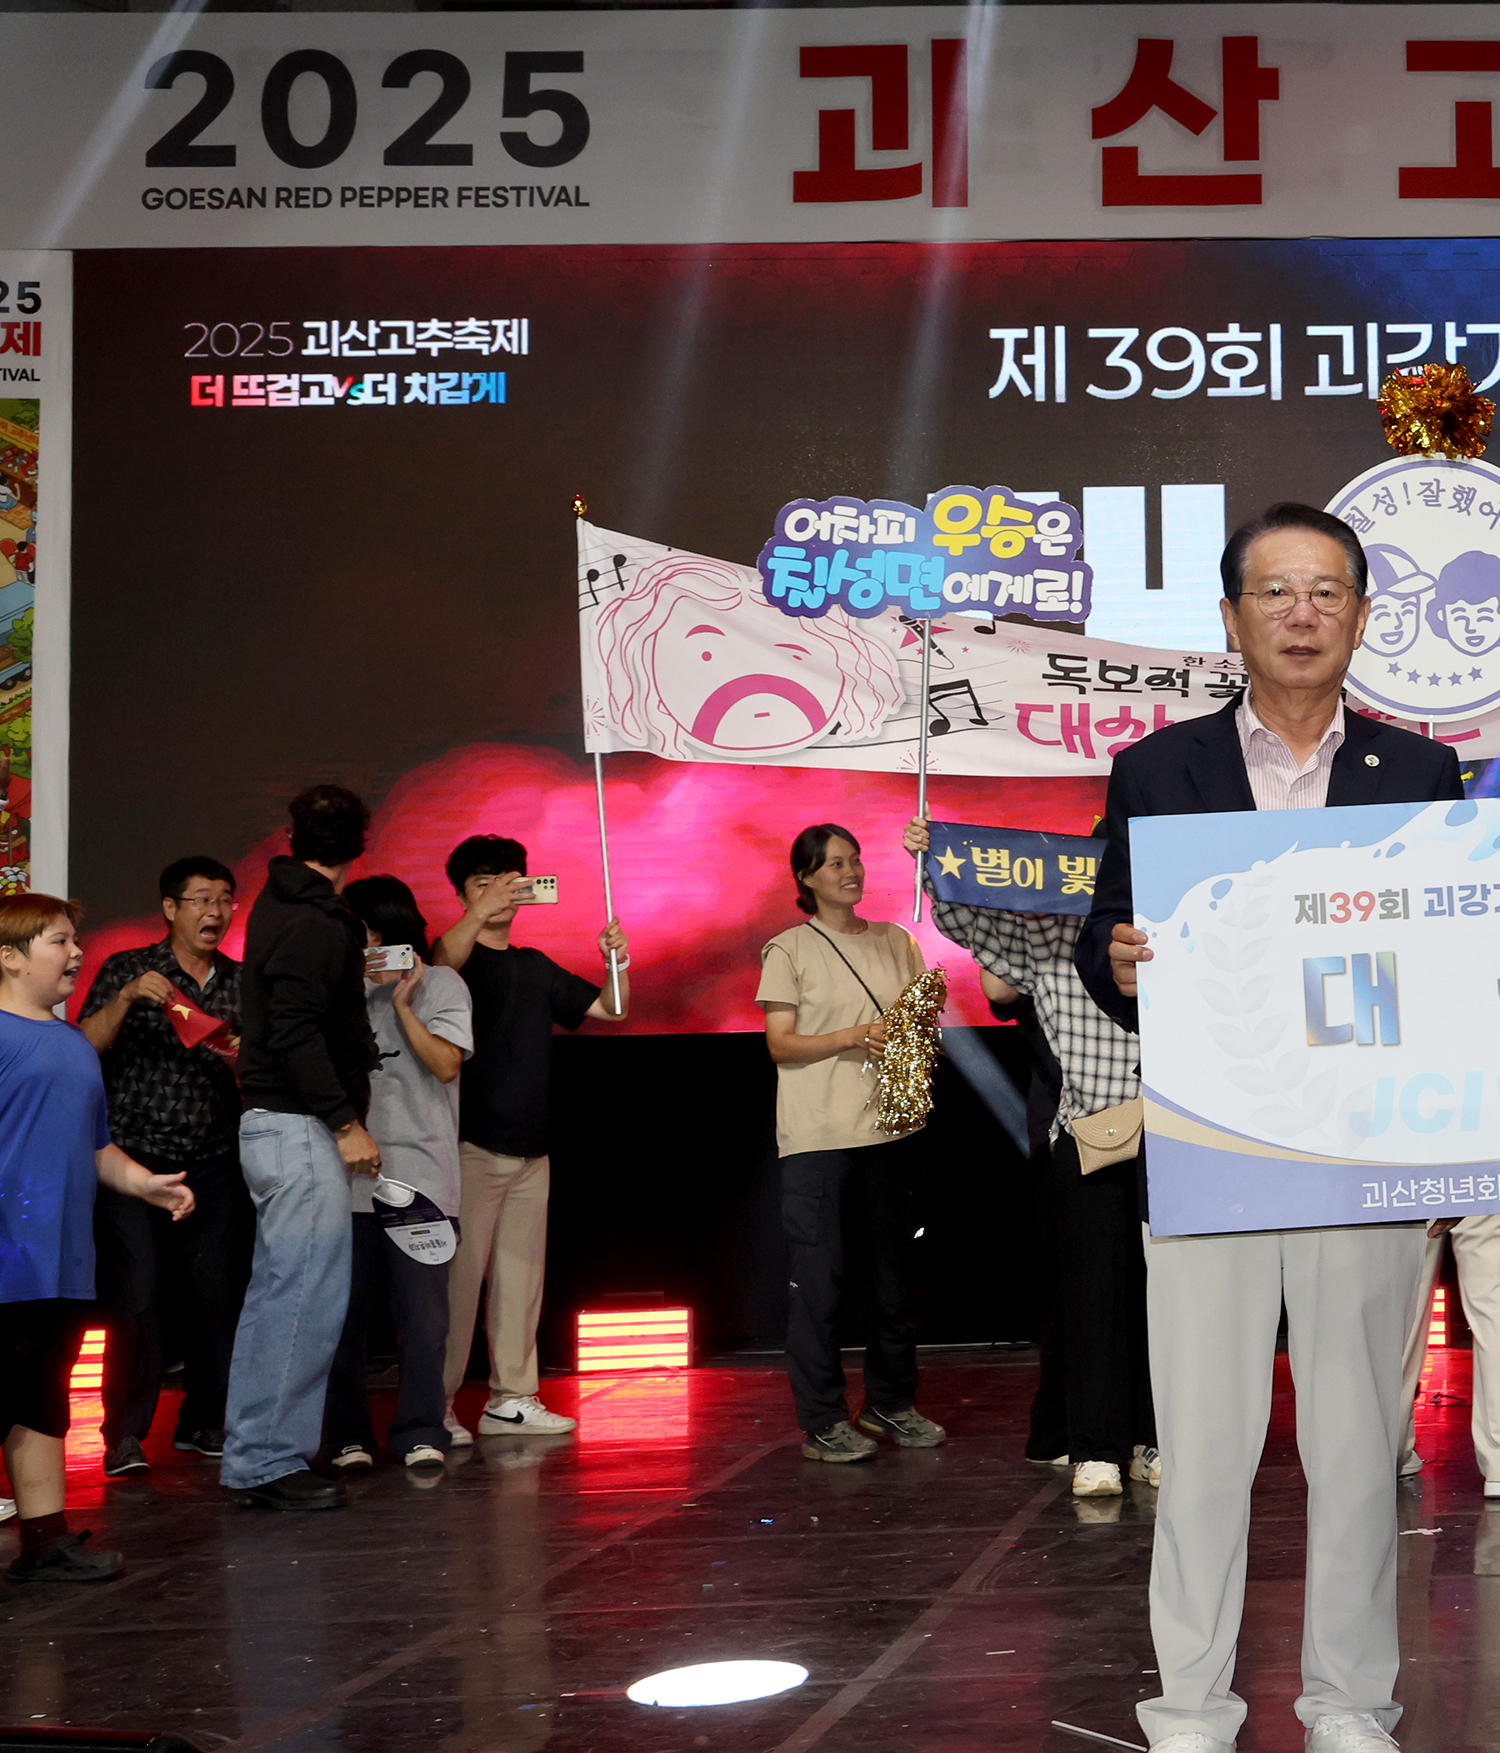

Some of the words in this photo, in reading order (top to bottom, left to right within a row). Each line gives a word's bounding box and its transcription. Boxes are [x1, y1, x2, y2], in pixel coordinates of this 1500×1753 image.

[144, 49, 590, 169] 2025
[142, 187, 267, 211] GOESAN
[275, 187, 332, 209] RED
[340, 186, 449, 209] PEPPER
[457, 185, 590, 209] FESTIVAL
[184, 322, 294, 358] 2025
[301, 317, 530, 358] 괴산고추축제
[989, 325, 1067, 403] 제
[1086, 322, 1283, 402] 39회
[190, 374, 225, 407] 더
[231, 373, 336, 407] 뜨겁고
[363, 372, 397, 406] 더
[403, 371, 507, 405] 차갑게
[784, 504, 916, 545] 어차피
[932, 493, 1074, 558] 우승은
[1042, 653, 1190, 697] 독보적
[1182, 656, 1206, 668] 한
[971, 845, 1044, 891] 별이
[1294, 888, 1410, 927] 제39회
[1349, 1069, 1484, 1138] JCI
